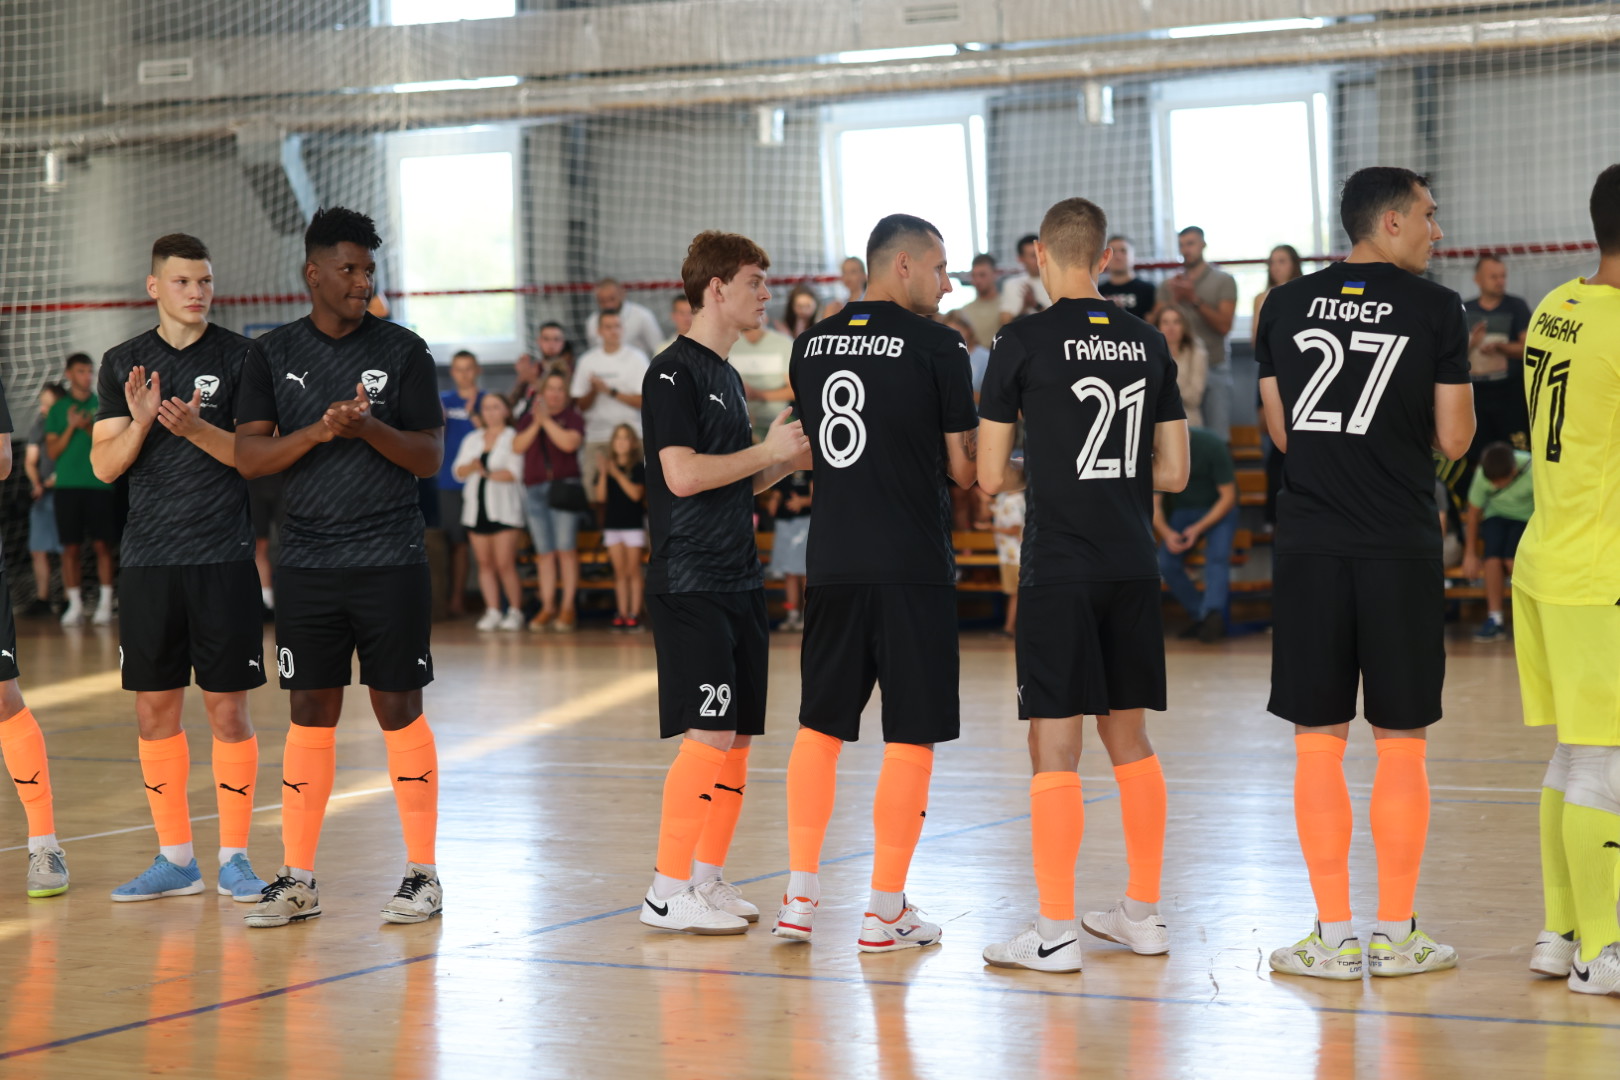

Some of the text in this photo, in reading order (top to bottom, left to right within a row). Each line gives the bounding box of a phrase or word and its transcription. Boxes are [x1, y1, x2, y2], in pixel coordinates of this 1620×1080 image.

[1532, 312, 1583, 344] РИБАК
[803, 335, 905, 358] ЛІТВІНОВ
[1063, 334, 1147, 361] ГАЙВАН
[1292, 328, 1410, 435] 27
[818, 369, 867, 468] 8
[1525, 345, 1572, 463] 71
[1070, 376, 1146, 480] 21
[276, 645, 294, 679] 0
[699, 683, 732, 717] 29
